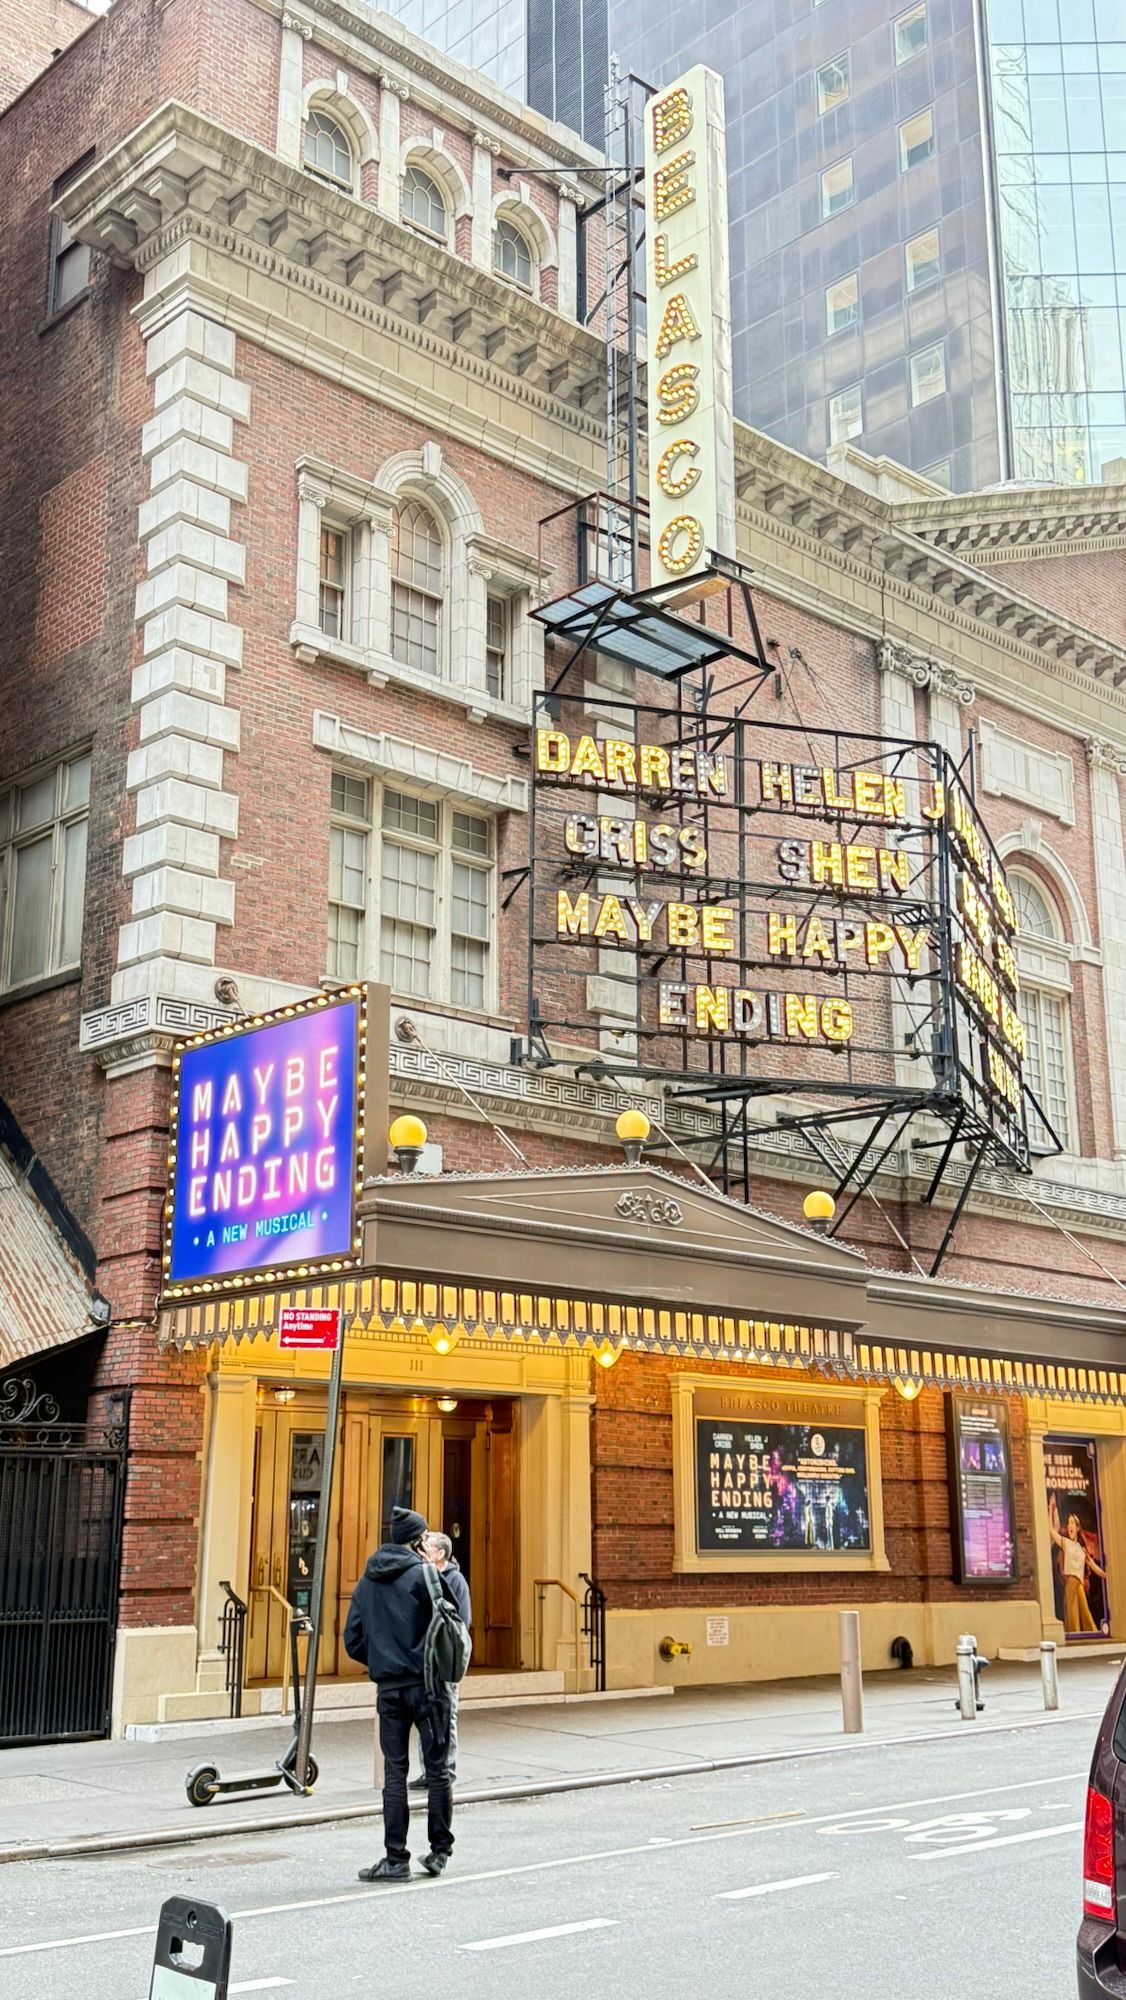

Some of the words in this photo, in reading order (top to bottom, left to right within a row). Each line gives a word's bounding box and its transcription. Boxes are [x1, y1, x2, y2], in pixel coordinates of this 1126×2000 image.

[653, 87, 705, 576] BELASCO
[536, 729, 729, 796] DARREN
[760, 760, 905, 819] HELEN
[921, 780, 945, 820] J
[564, 812, 707, 868] CRISS
[779, 838, 910, 892] SHEN
[557, 890, 736, 951] MAYBE
[768, 912, 931, 971] HAPPY
[658, 980, 854, 1041] ENDING
[192, 1046, 339, 1123] MAYBE
[190, 1095, 339, 1169] HAPPY
[188, 1146, 337, 1217] ENDING
[205, 1231, 215, 1248] A
[222, 1223, 248, 1245] NEW
[255, 1211, 315, 1239] MUSICAL
[283, 1311, 294, 1321] NO
[295, 1311, 333, 1322] STANDING
[283, 1321, 314, 1332] Anytime
[721, 1397, 780, 1412] BELASCO
[785, 1401, 841, 1416] THEATRE
[710, 1452, 771, 1471] MAYBE
[710, 1471, 772, 1490] HAPPY
[711, 1490, 773, 1508] ENDING
[718, 1510, 724, 1519] A
[726, 1511, 739, 1520] NEW
